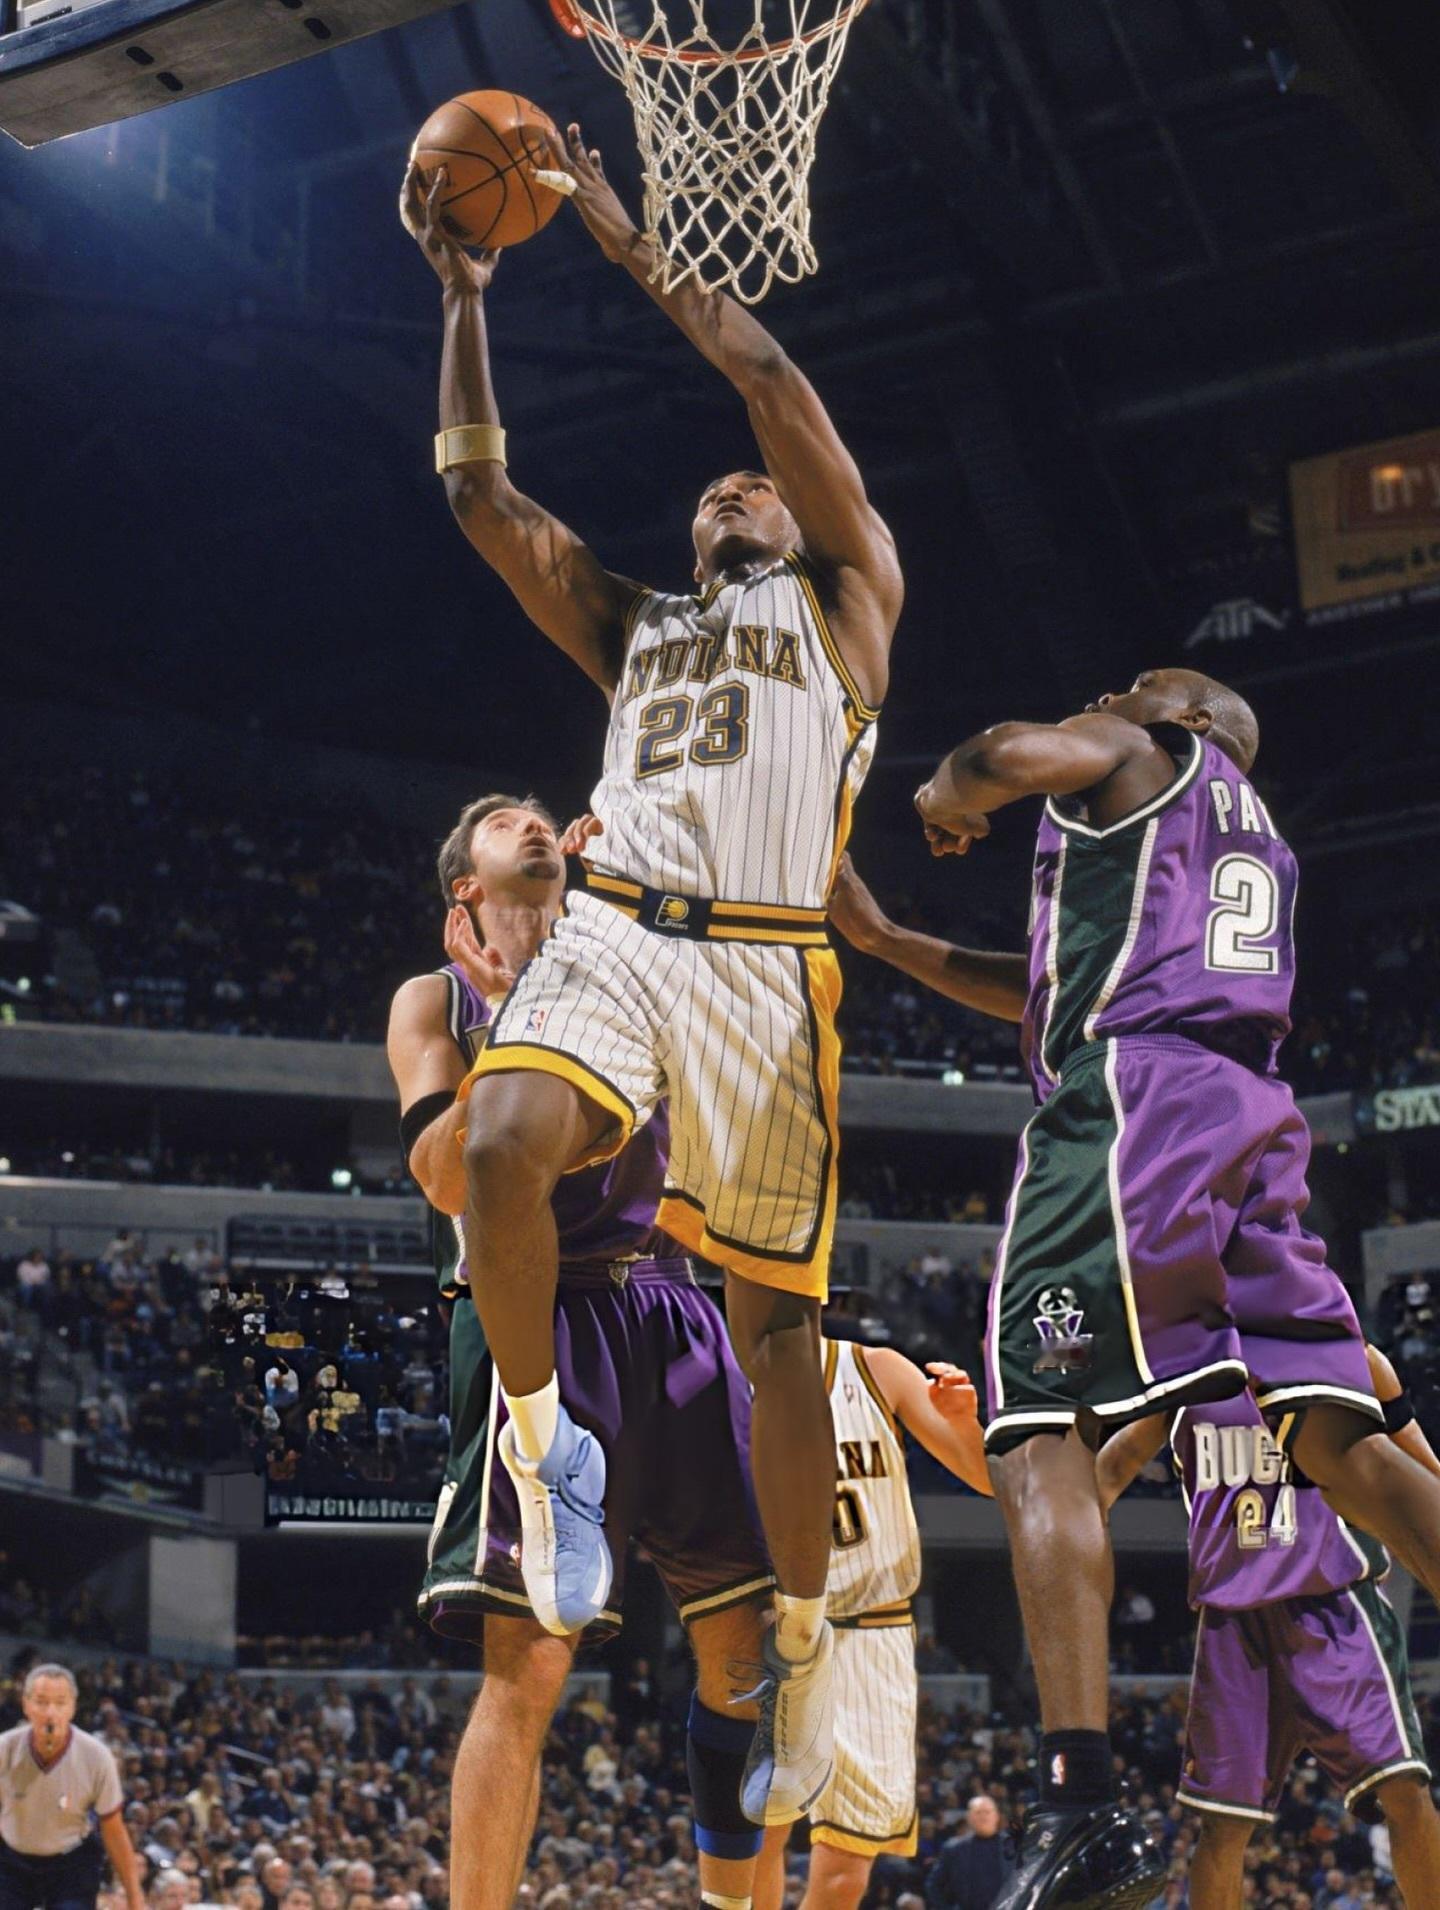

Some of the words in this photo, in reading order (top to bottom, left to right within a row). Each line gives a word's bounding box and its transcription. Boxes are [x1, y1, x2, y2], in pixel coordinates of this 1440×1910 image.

[635, 680, 750, 781] 23
[1204, 852, 1279, 975] 2
[1234, 1484, 1298, 1550] 24
